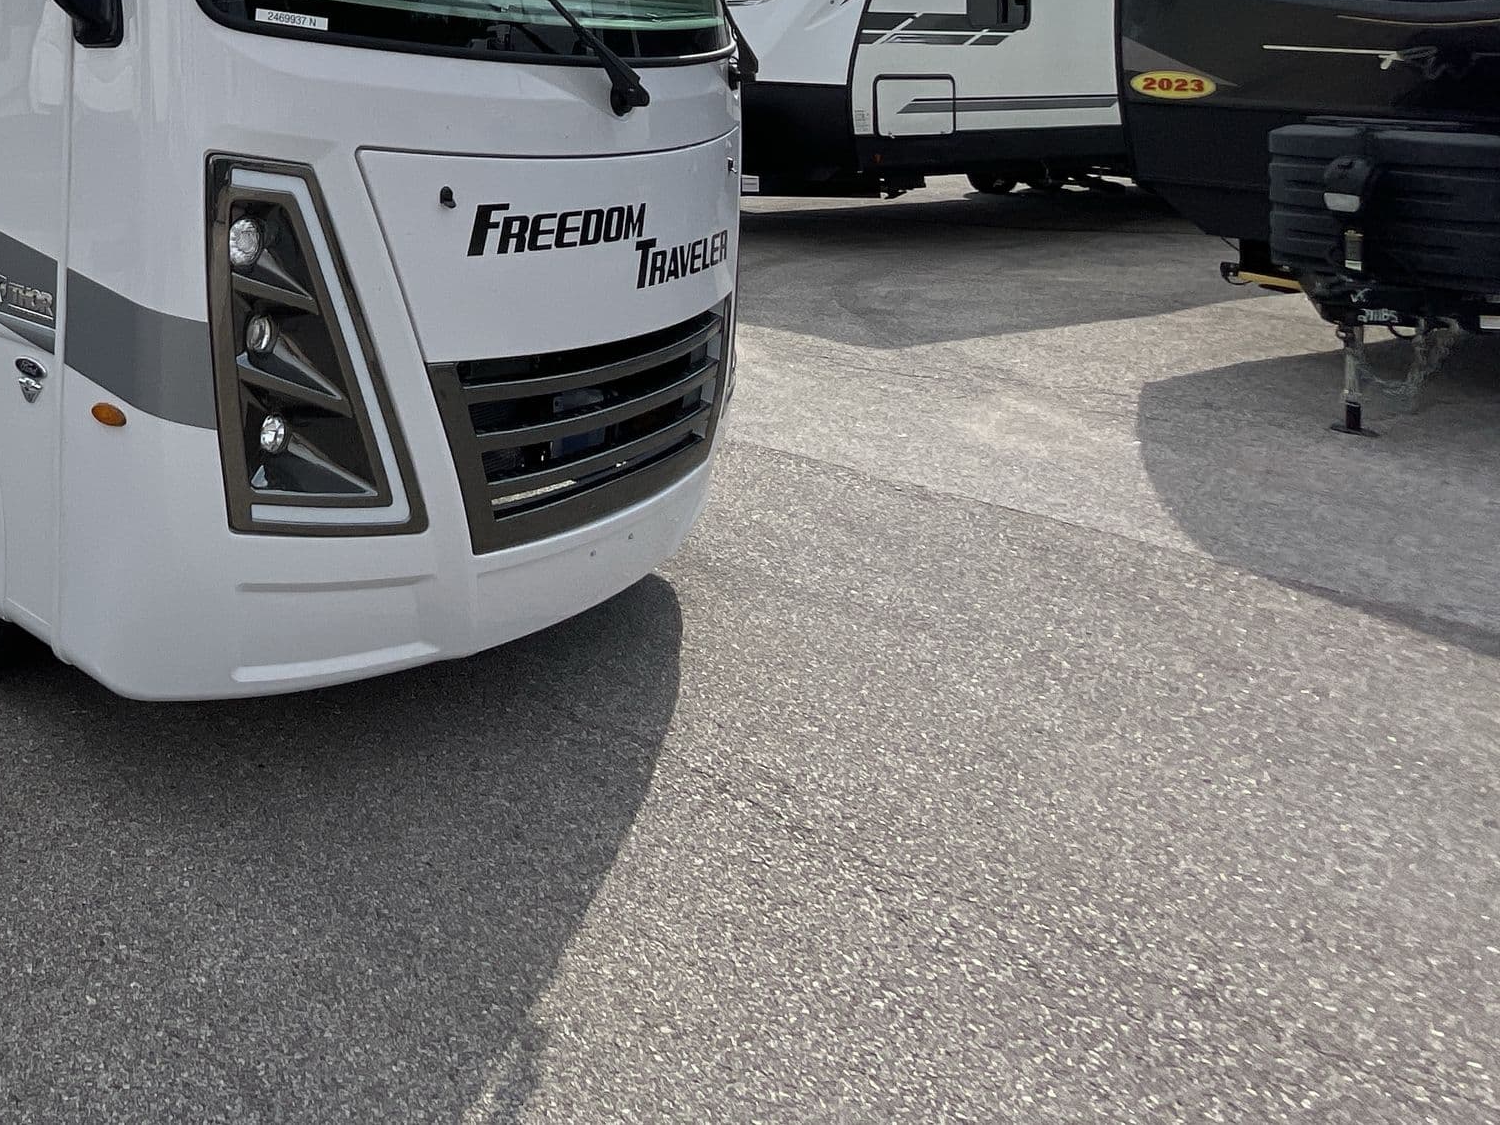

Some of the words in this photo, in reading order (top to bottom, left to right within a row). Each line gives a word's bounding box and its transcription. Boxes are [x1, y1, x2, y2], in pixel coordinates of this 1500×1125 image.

[309, 18, 317, 27] N
[1142, 77, 1204, 93] 2023
[467, 203, 647, 257] FREEDOM
[635, 230, 729, 290] TRAVELER
